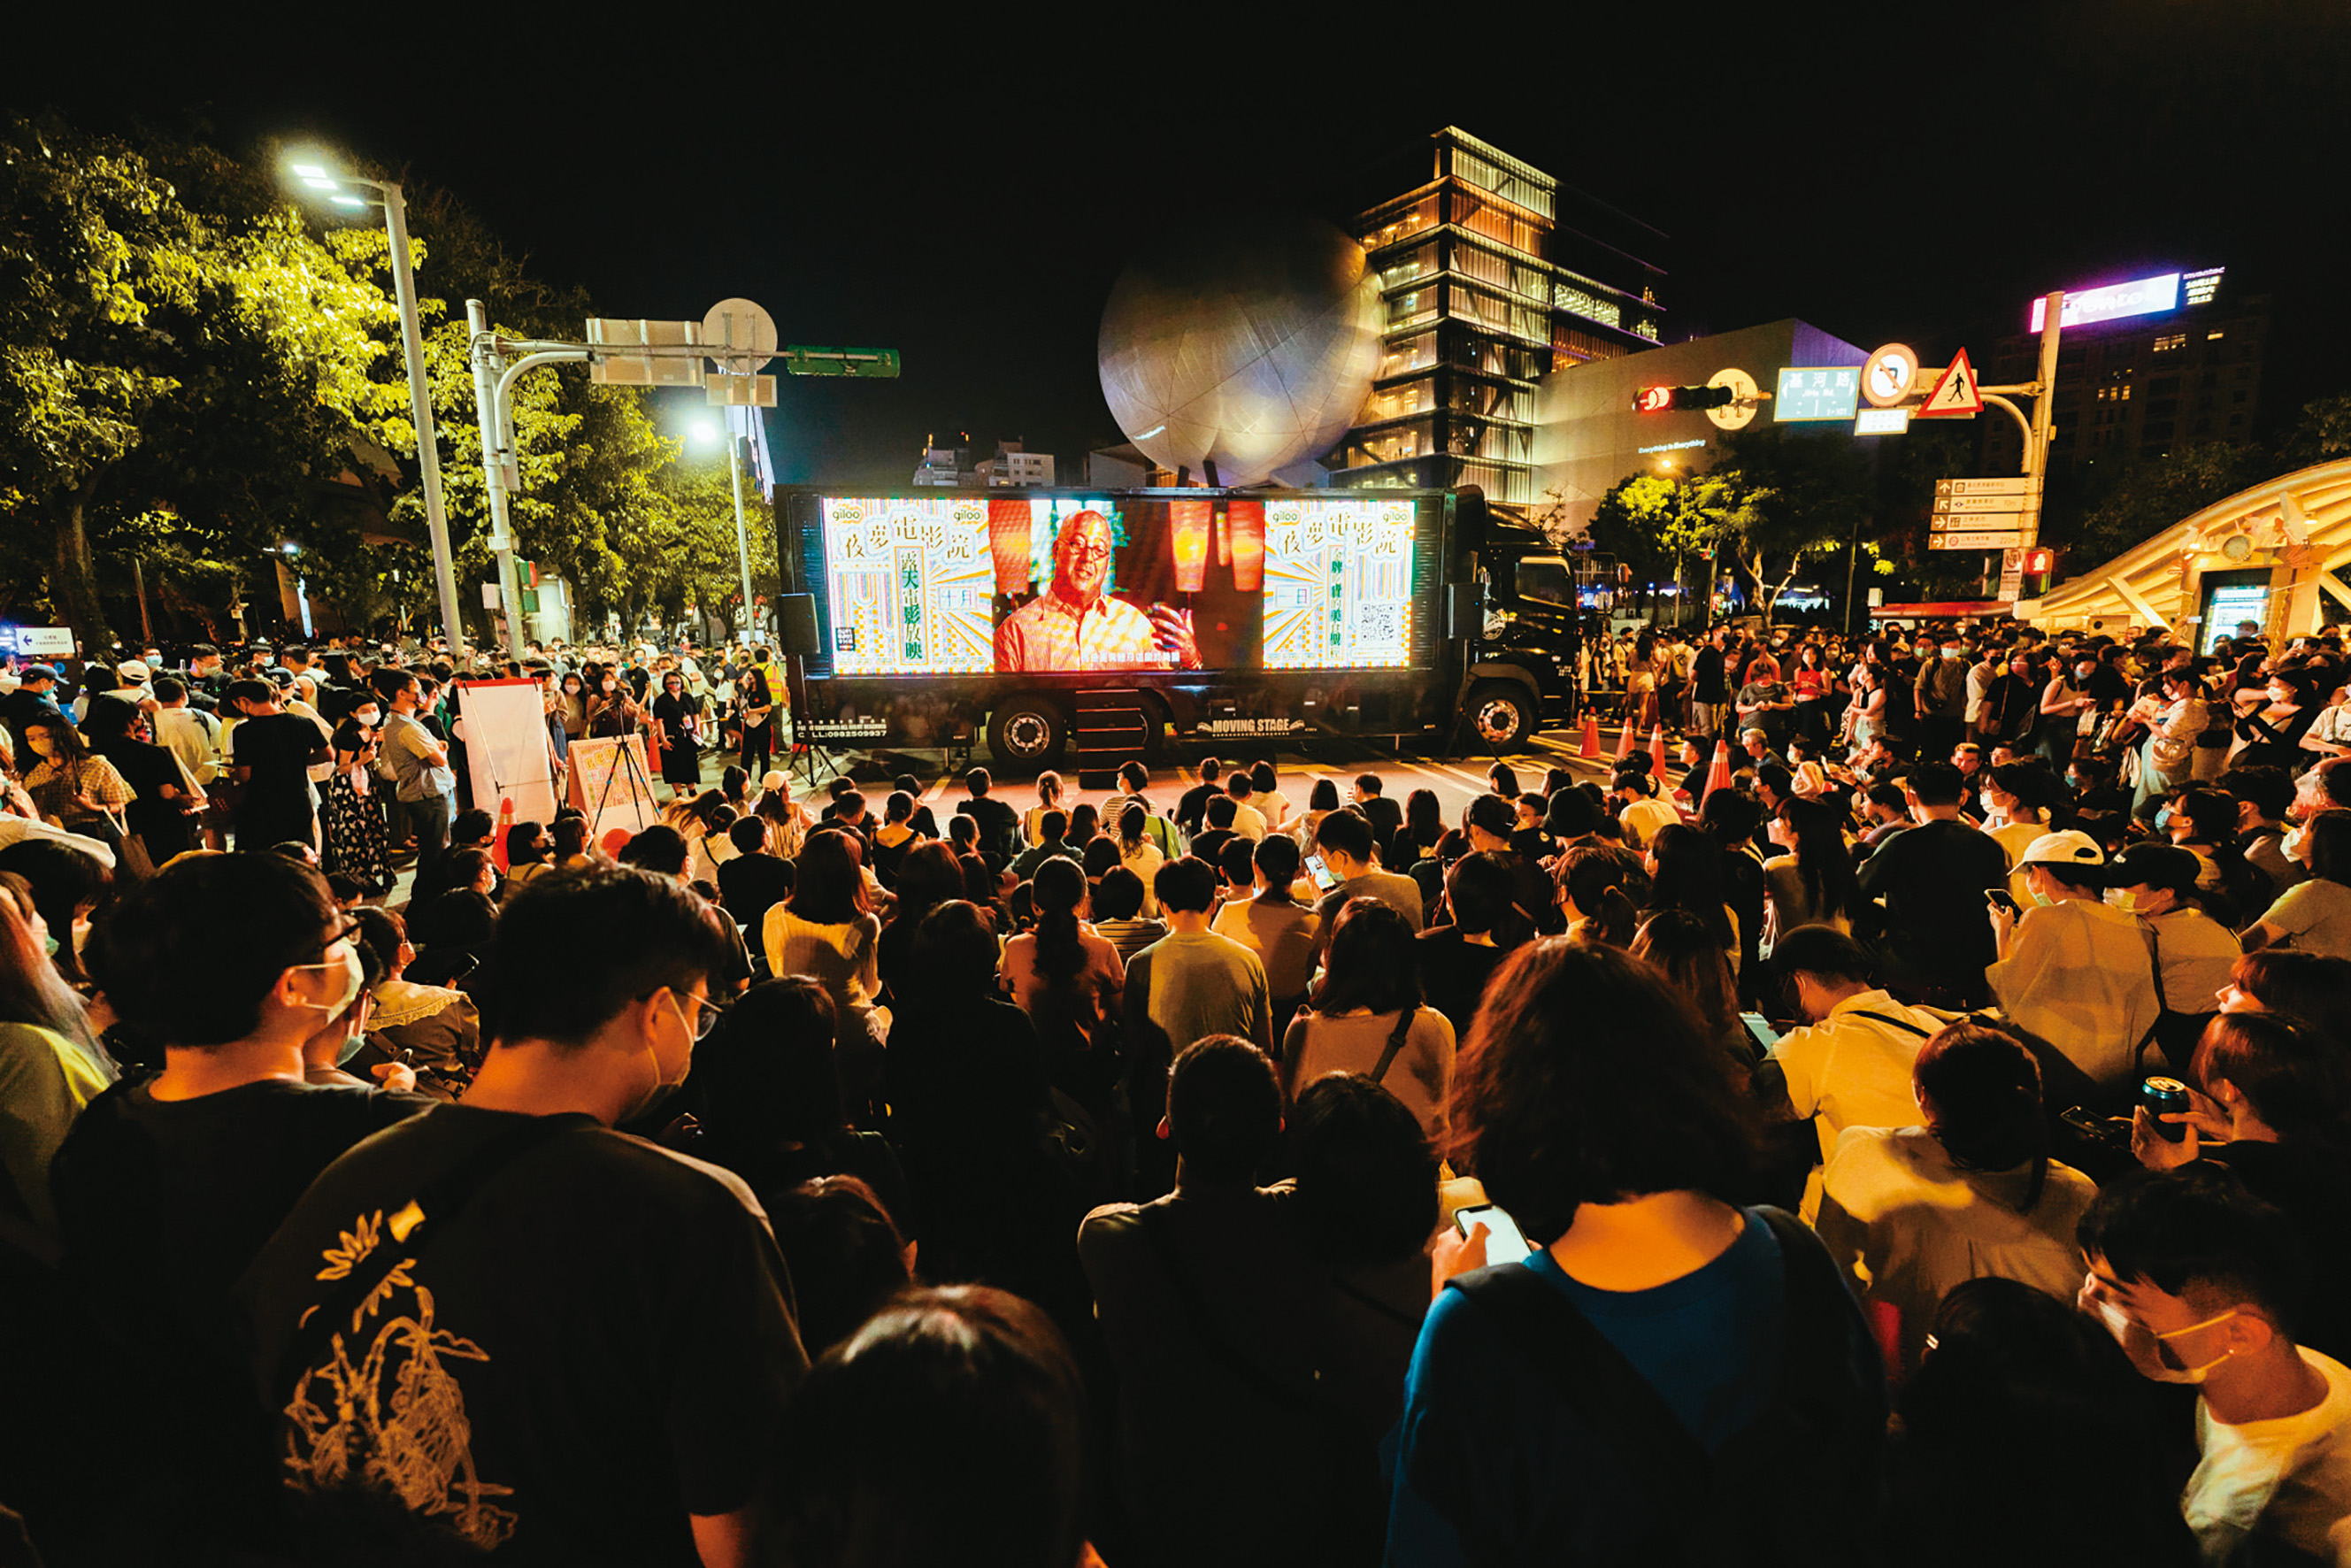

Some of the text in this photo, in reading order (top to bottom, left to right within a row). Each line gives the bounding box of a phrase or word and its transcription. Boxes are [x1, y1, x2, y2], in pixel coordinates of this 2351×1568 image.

[1789, 372, 1850, 388] 基河路
[832, 508, 860, 521] giloo
[953, 509, 981, 522] giloo
[1272, 511, 1298, 523] giloo
[1382, 511, 1408, 523] giloo
[845, 515, 970, 558] 夜夢電影院
[1284, 512, 1396, 555] 夜夢電影院
[941, 589, 972, 607] 十月
[1279, 588, 1307, 604] 一日
[903, 552, 922, 660] 露天電影放映
[1212, 719, 1290, 734] MOVING STAGE
